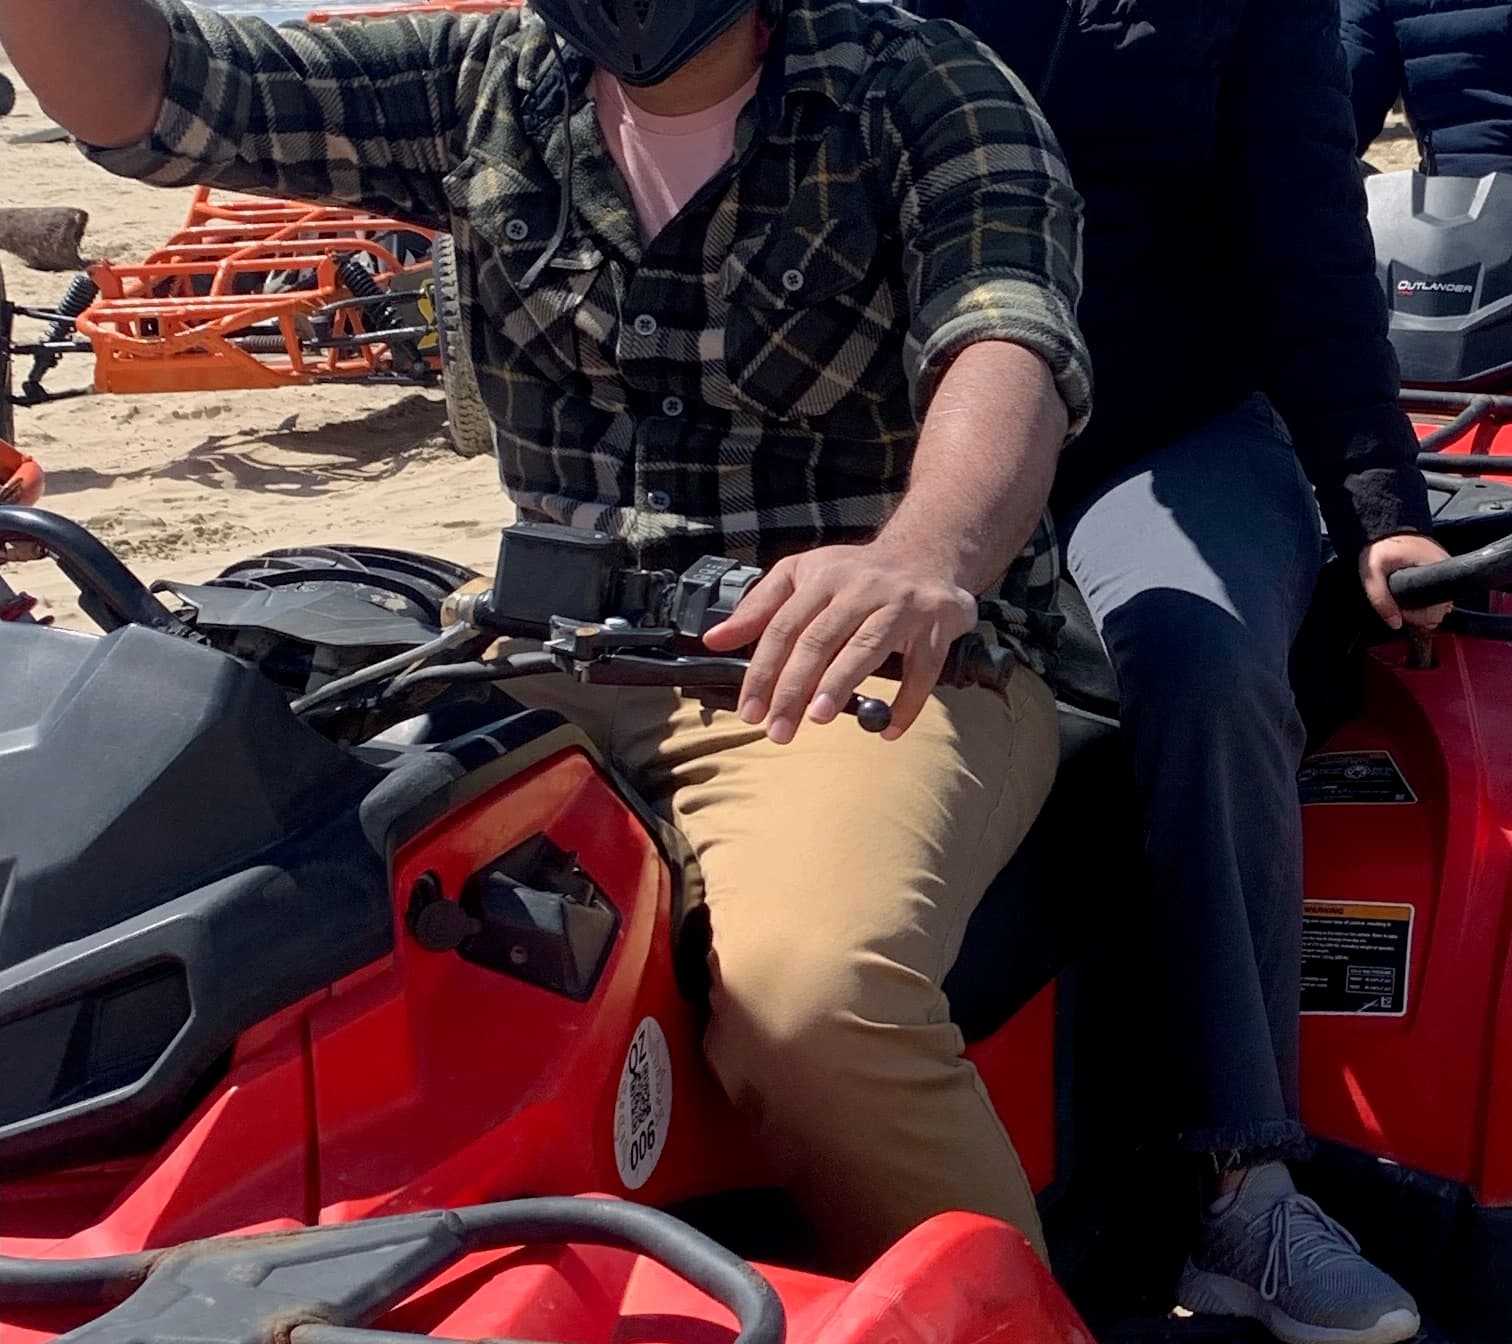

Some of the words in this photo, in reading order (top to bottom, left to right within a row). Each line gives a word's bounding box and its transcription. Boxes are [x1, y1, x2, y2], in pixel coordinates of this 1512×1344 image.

[1397, 279, 1473, 293] OUTLANDER
[628, 1028, 648, 1082] QZ
[629, 1119, 656, 1173] 006
